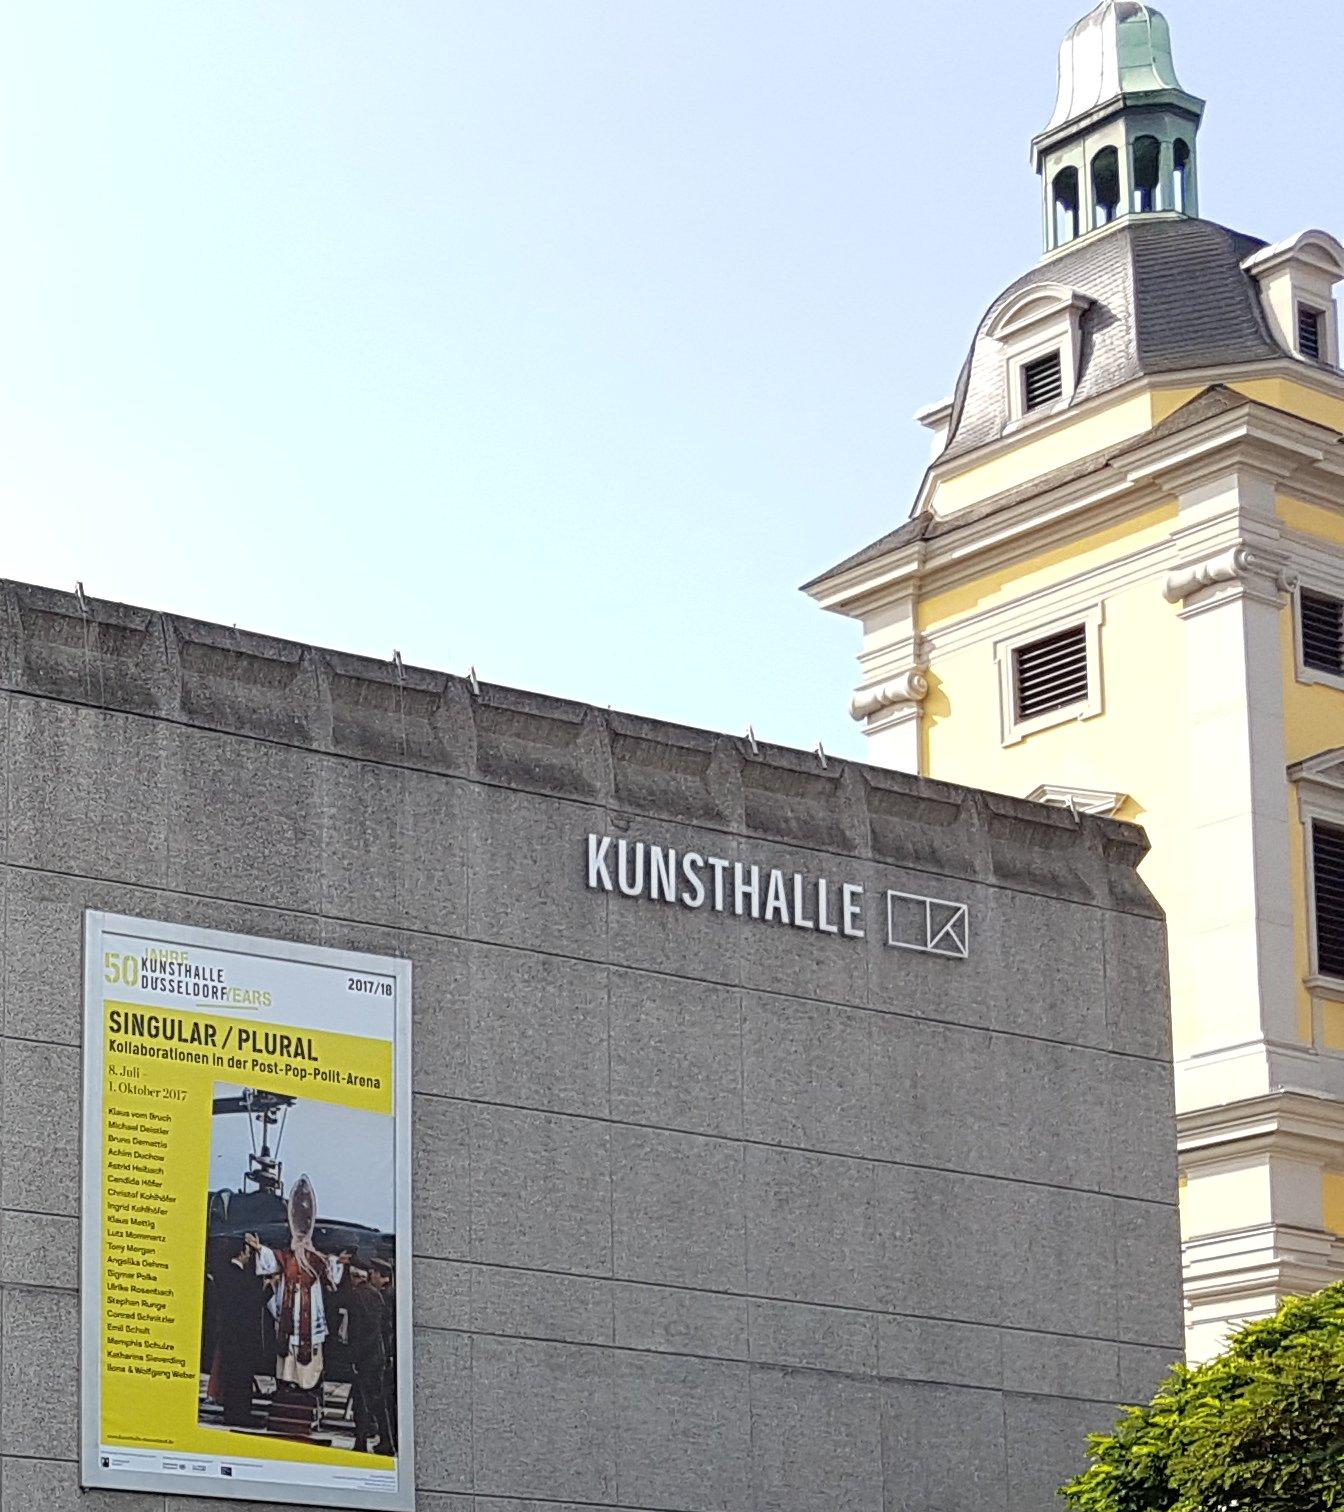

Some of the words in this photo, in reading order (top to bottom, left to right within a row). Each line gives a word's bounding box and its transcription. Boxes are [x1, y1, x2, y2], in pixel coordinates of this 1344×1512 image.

[586, 832, 866, 939] KUNSTHALLE
[104, 951, 140, 988] 50
[141, 957, 225, 984] KUNSTHALLE
[347, 977, 393, 997] 2017/18
[109, 1010, 218, 1048] SINGULAR
[237, 1027, 319, 1062] PLURAL
[109, 1039, 209, 1065] Kollaborationen
[212, 1052, 224, 1067] in
[227, 1055, 249, 1070] der
[251, 1058, 381, 1090] Post-Pop-Polit-Arena
[120, 1065, 140, 1078] Juli
[118, 1082, 162, 1098] Oktober
[163, 1088, 188, 1102] 2017
